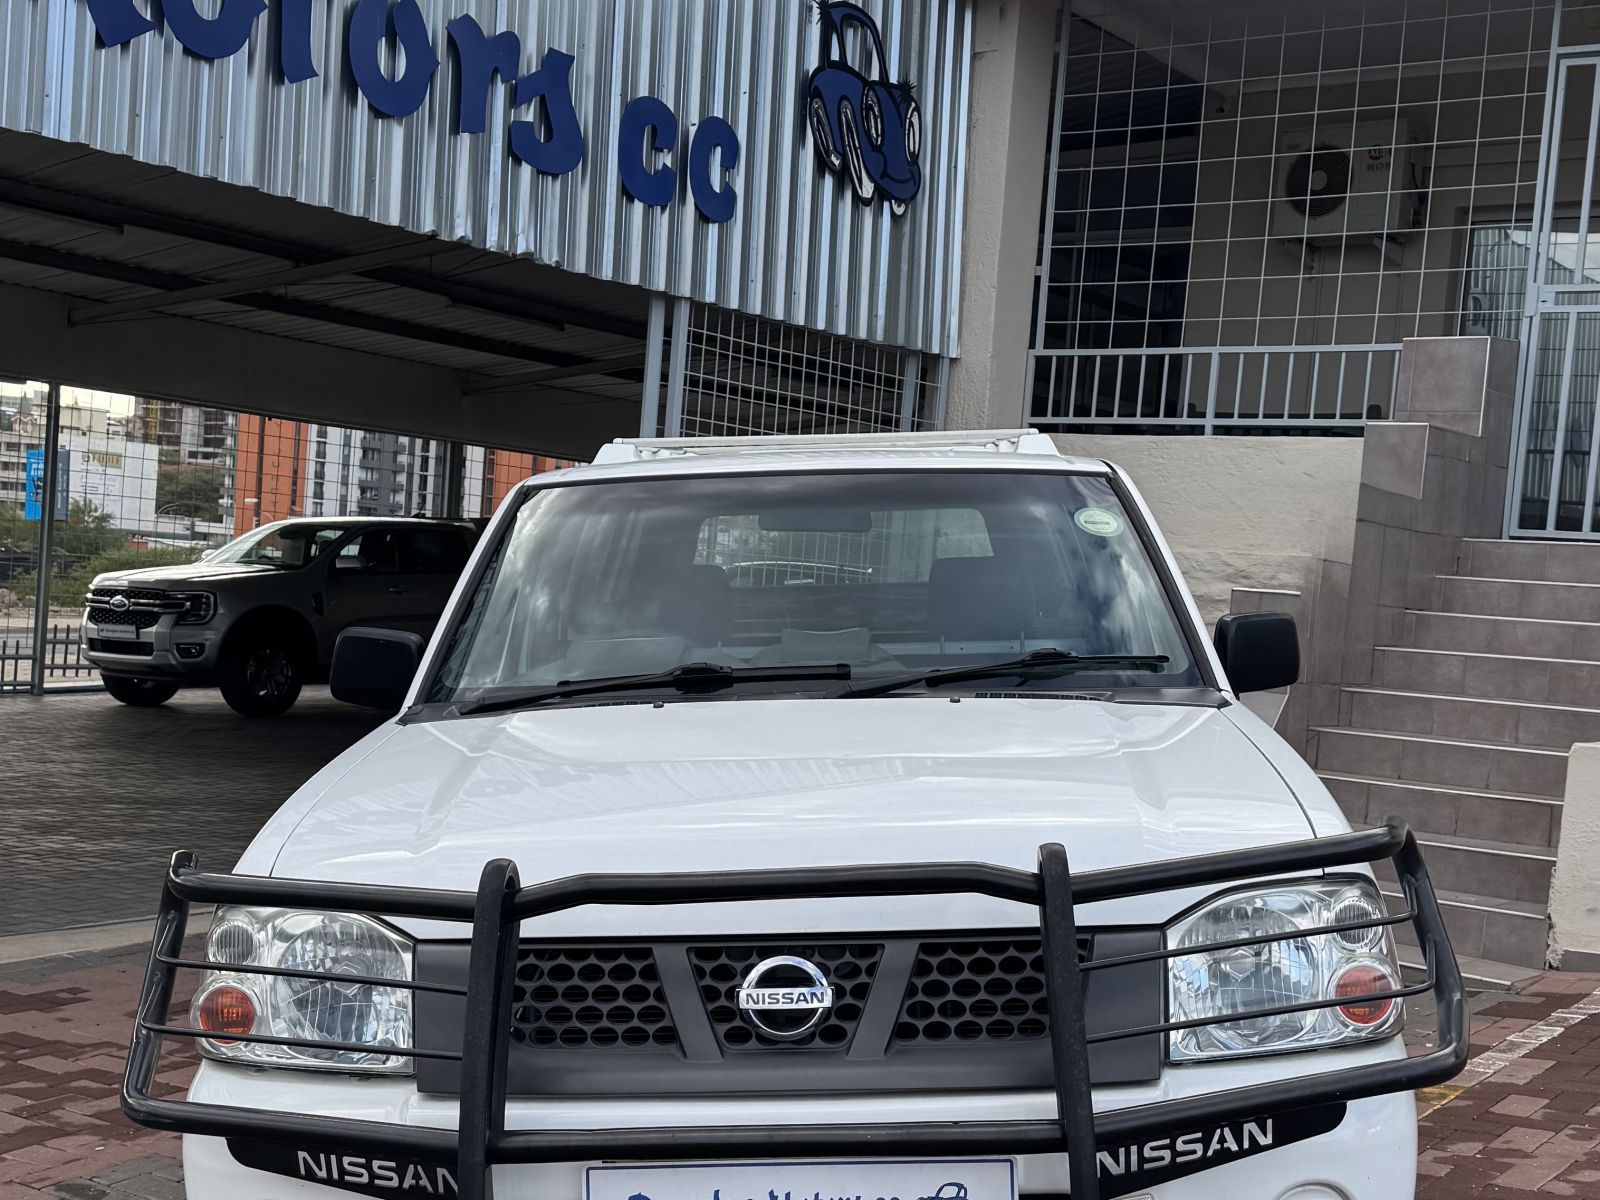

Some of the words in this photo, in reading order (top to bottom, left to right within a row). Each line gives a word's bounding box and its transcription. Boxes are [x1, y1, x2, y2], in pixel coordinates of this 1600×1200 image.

[618, 96, 739, 223] cc
[745, 991, 825, 1005] NISSAN
[1097, 1119, 1273, 1178] NISSAN
